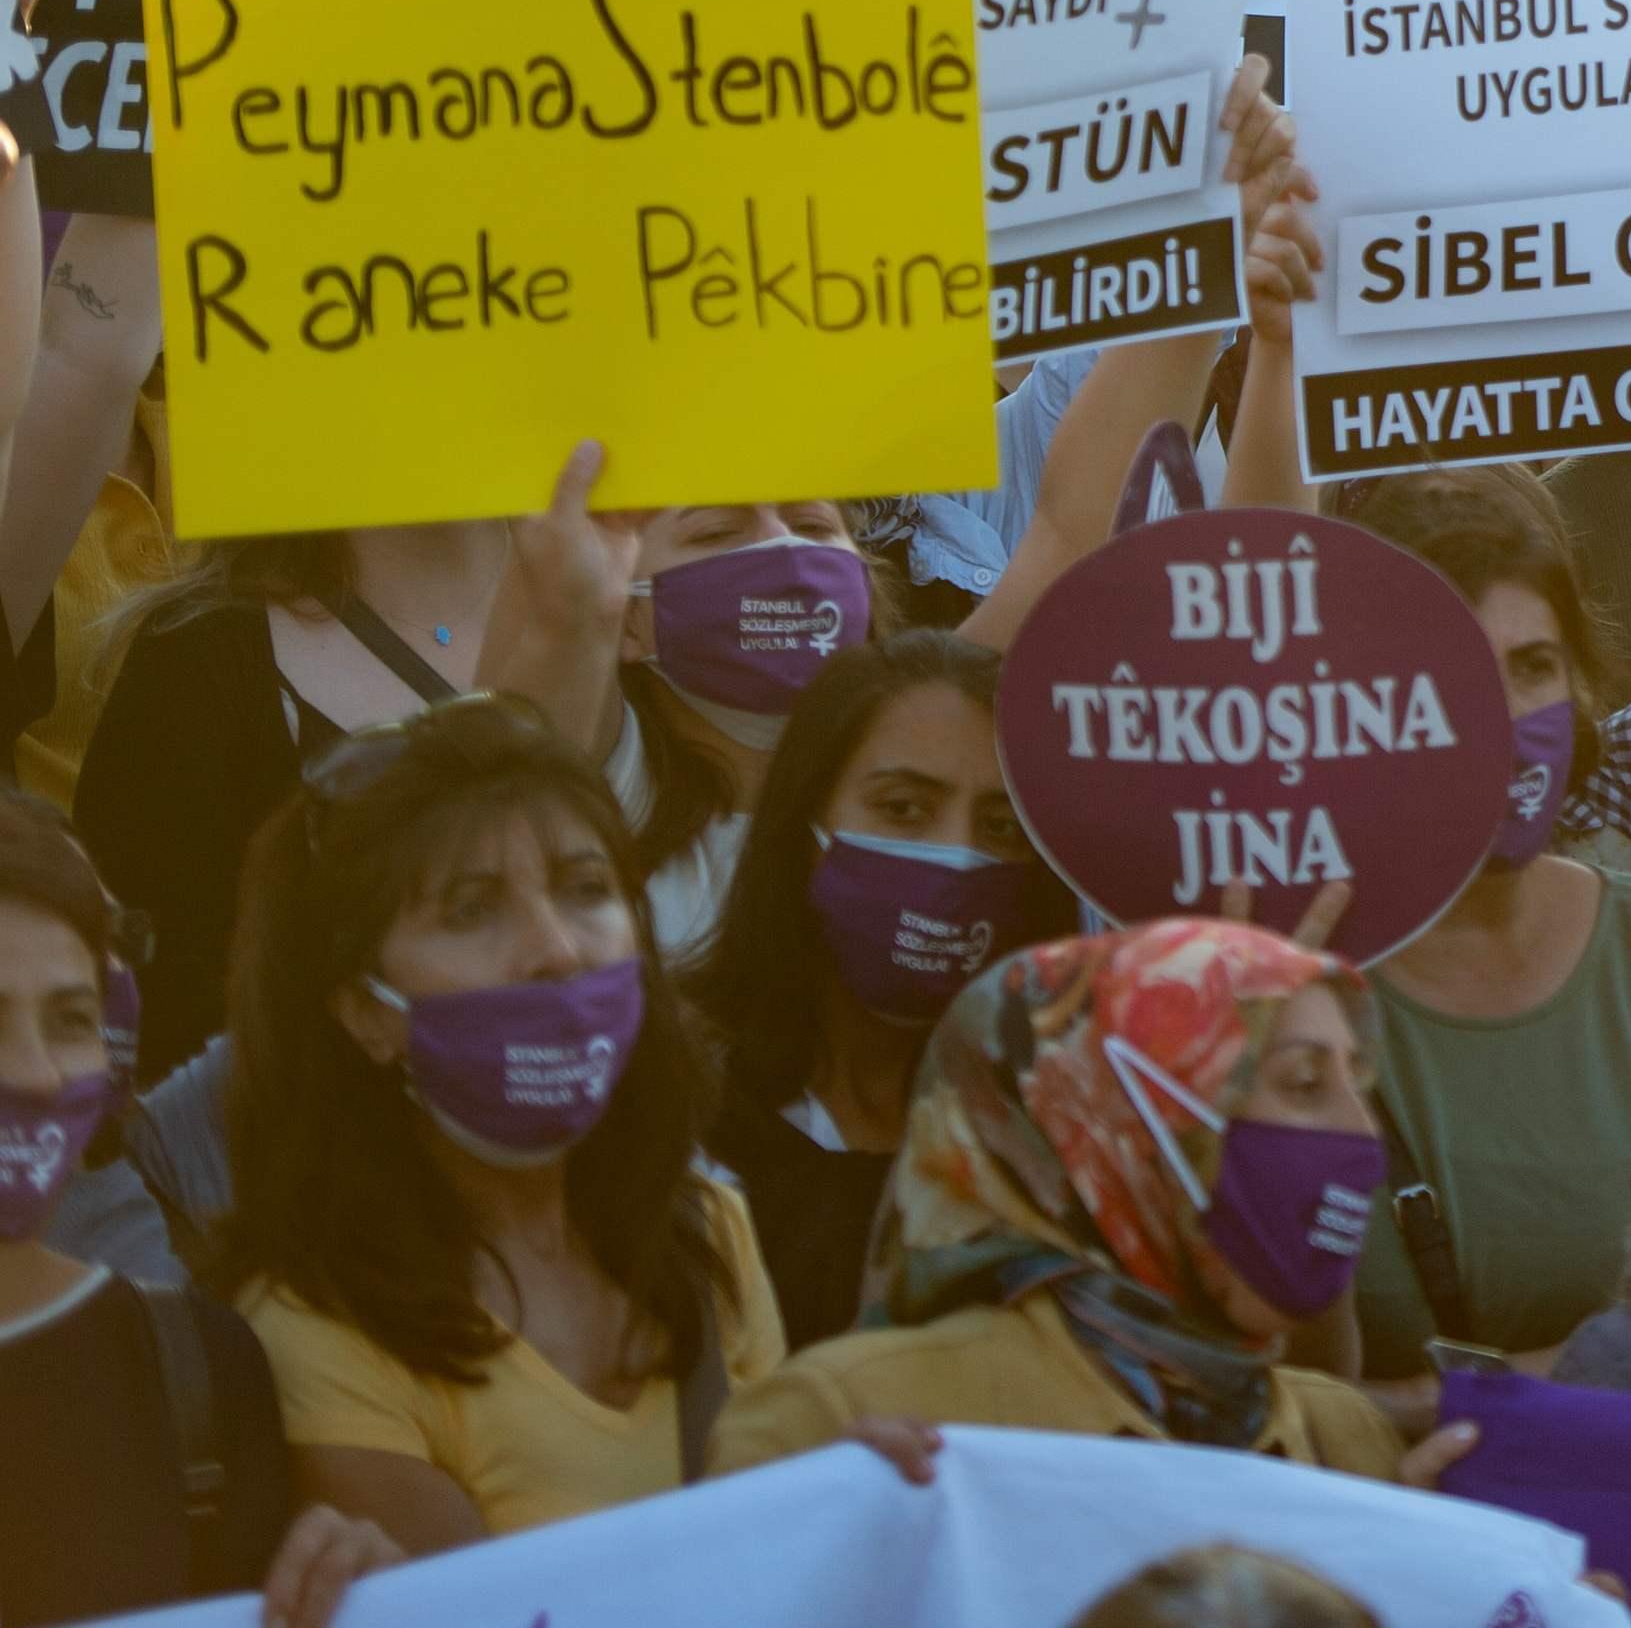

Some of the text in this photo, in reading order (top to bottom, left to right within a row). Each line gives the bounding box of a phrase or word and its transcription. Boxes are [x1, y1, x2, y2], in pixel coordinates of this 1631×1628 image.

[1360, 214, 1591, 306] SİBEL
[1331, 372, 1603, 454] HAYATTA
[740, 595, 805, 614] İSTANBUL
[1165, 533, 1323, 664] BİJÎ
[1052, 660, 1458, 786] TÊKOŞİNA
[1172, 789, 1355, 905] JİNA
